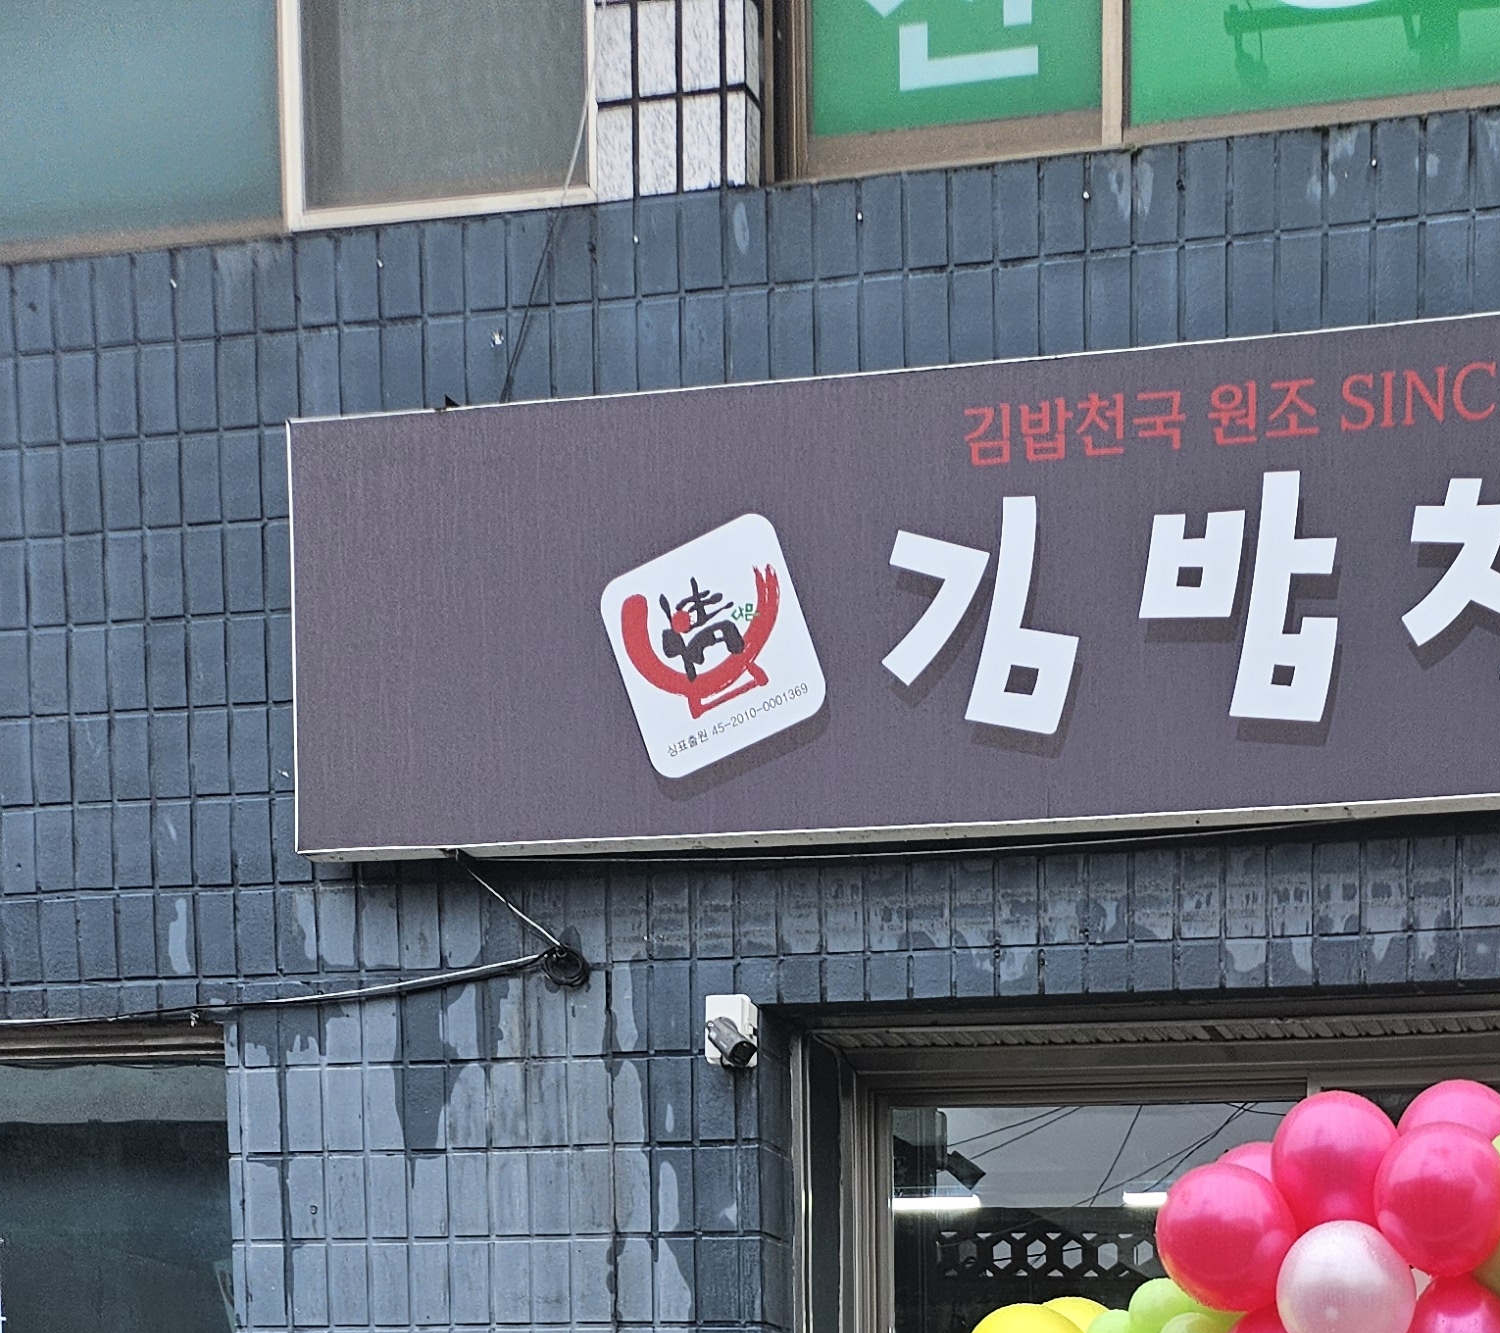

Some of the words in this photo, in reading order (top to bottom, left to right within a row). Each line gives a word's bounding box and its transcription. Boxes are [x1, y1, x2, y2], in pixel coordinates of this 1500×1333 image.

[964, 391, 1187, 466] 김밥천국
[1208, 379, 1320, 446] 원조
[711, 683, 809, 737] 45-2010-0001369
